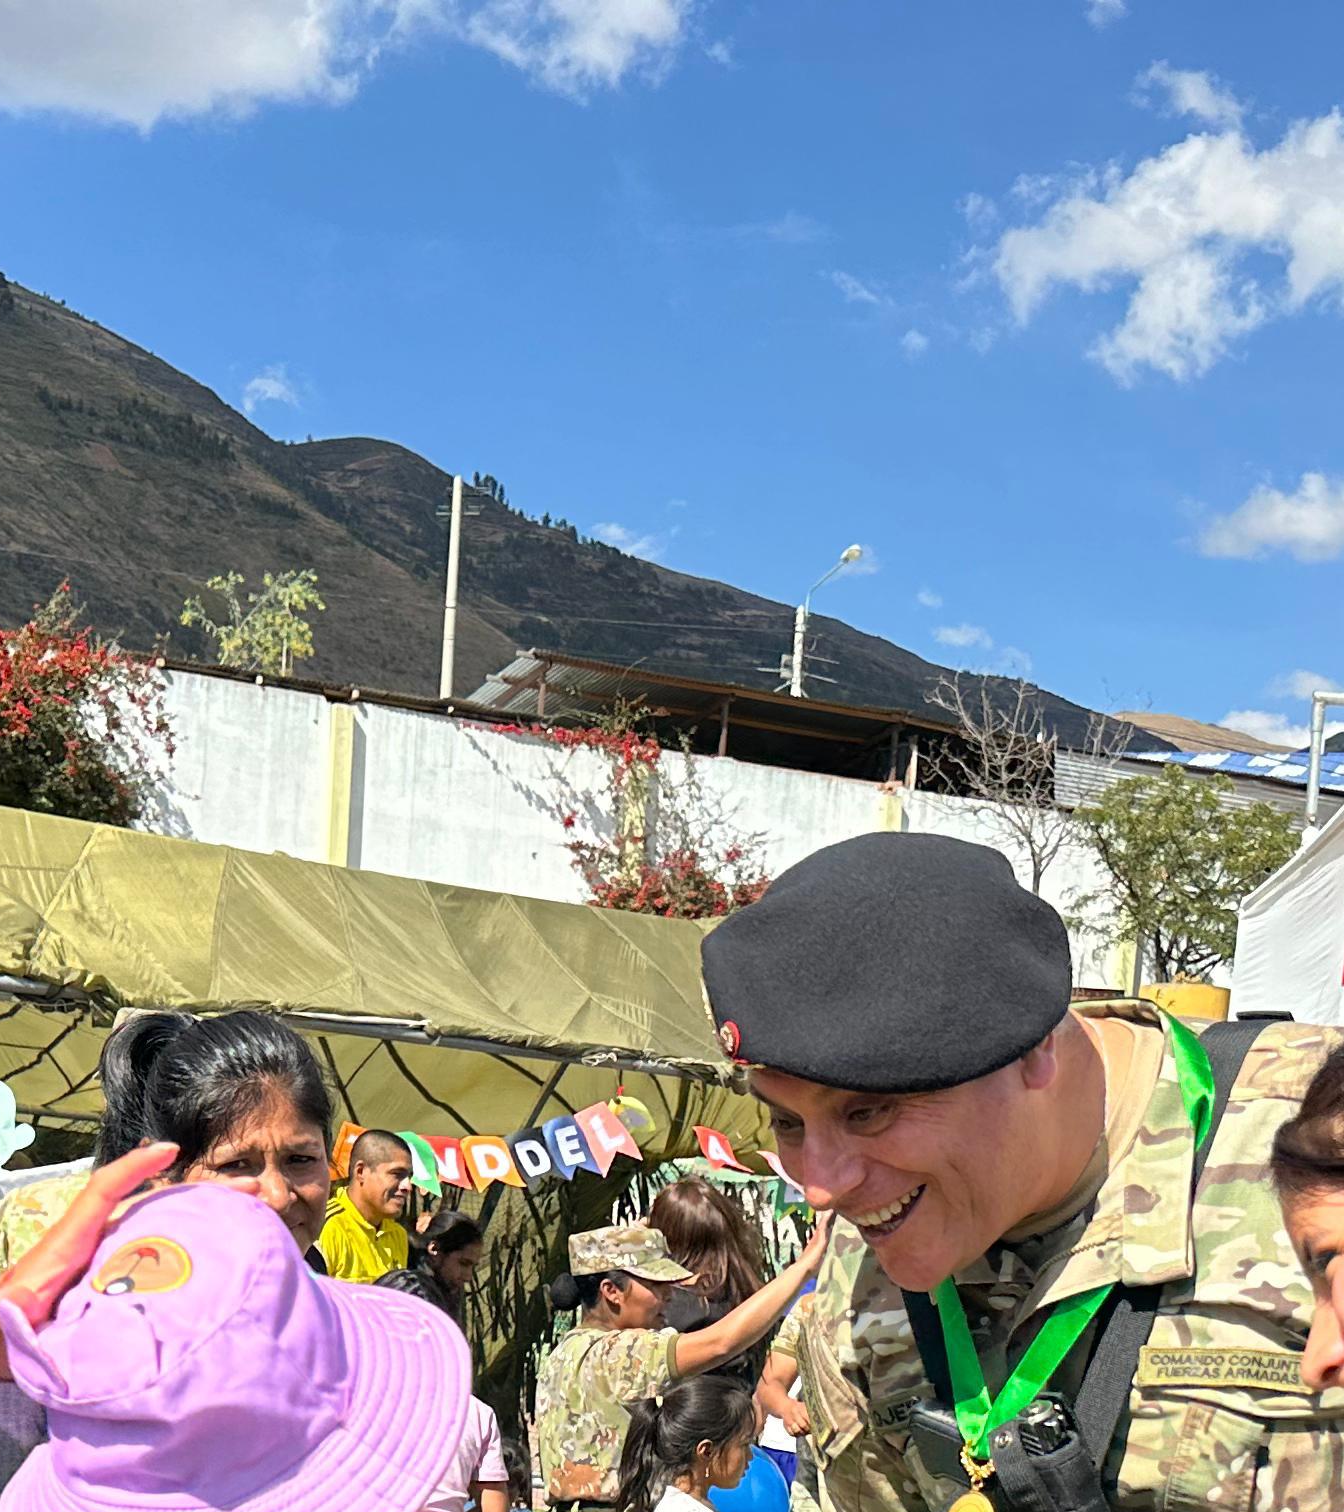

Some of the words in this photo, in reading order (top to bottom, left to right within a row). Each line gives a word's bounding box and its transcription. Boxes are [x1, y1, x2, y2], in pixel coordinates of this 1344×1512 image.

[1149, 1353, 1226, 1367] COMANDO
[1227, 1354, 1302, 1371] CONJUNT
[1156, 1366, 1222, 1379] FUERZAS
[1223, 1368, 1301, 1384] ARMADAS
